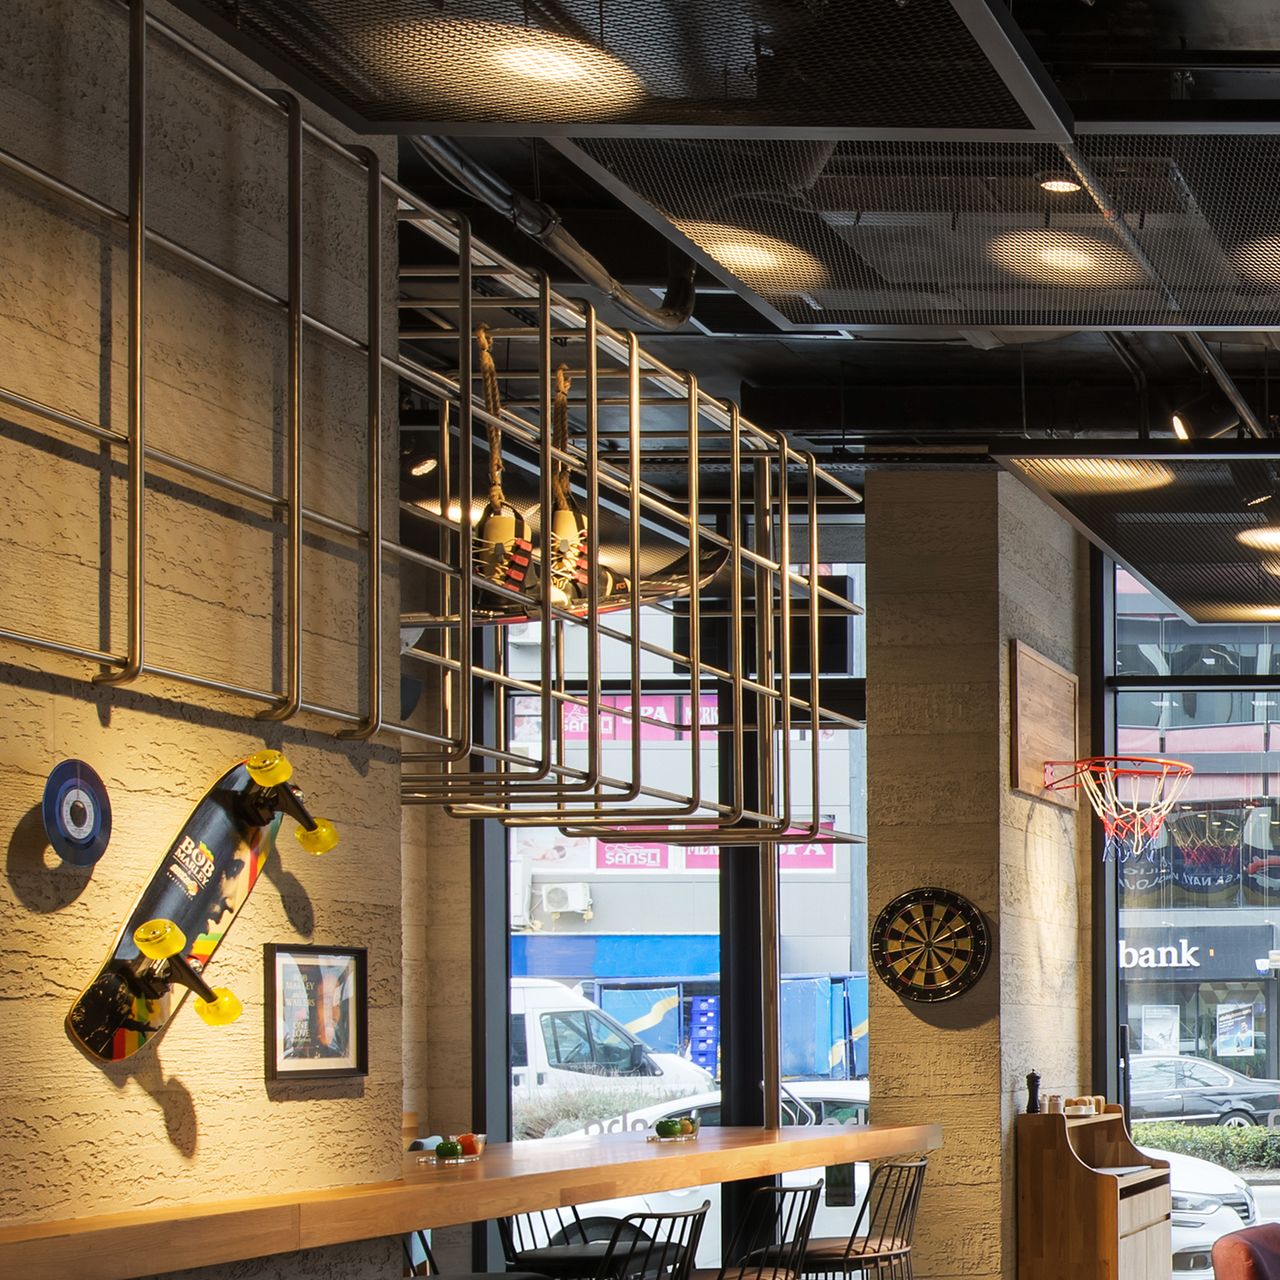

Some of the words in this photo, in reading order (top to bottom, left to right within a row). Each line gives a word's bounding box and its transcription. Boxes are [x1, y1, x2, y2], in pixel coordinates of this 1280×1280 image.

[174, 847, 210, 886] MARLEY
[180, 835, 215, 878] BOB
[1118, 938, 1201, 969] bank
